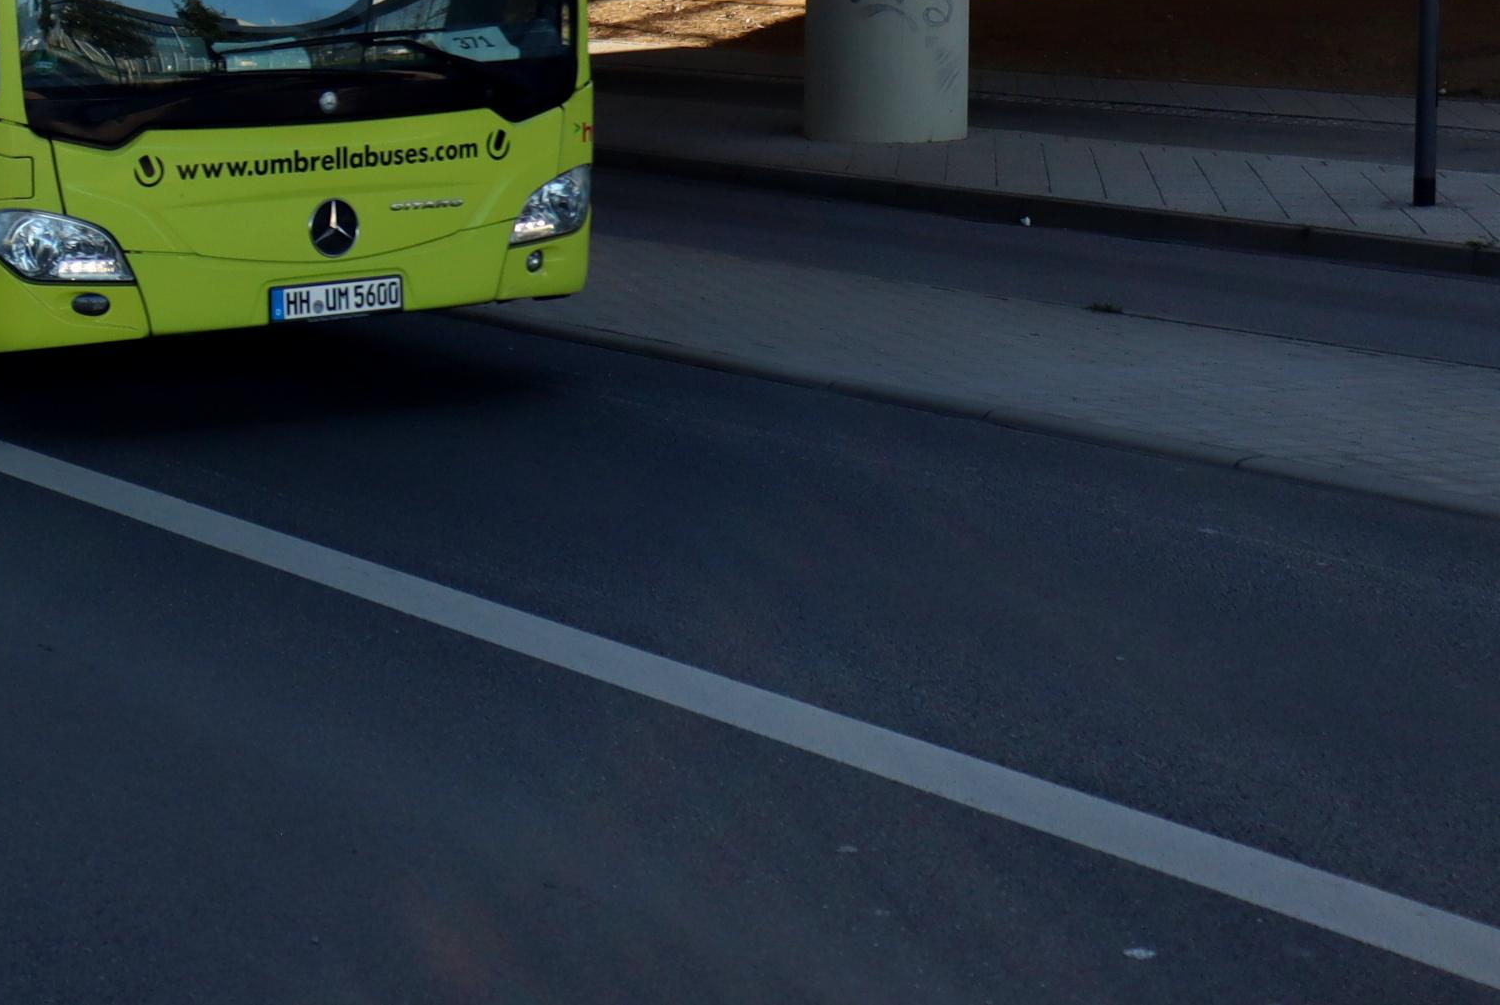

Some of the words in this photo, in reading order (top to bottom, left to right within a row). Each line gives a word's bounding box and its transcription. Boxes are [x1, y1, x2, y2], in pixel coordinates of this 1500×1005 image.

[452, 34, 496, 51] 371
[176, 139, 479, 181] www.umbrellabuses.com
[286, 290, 311, 316] HH
[325, 286, 349, 311] UM
[353, 281, 399, 309] 5600
